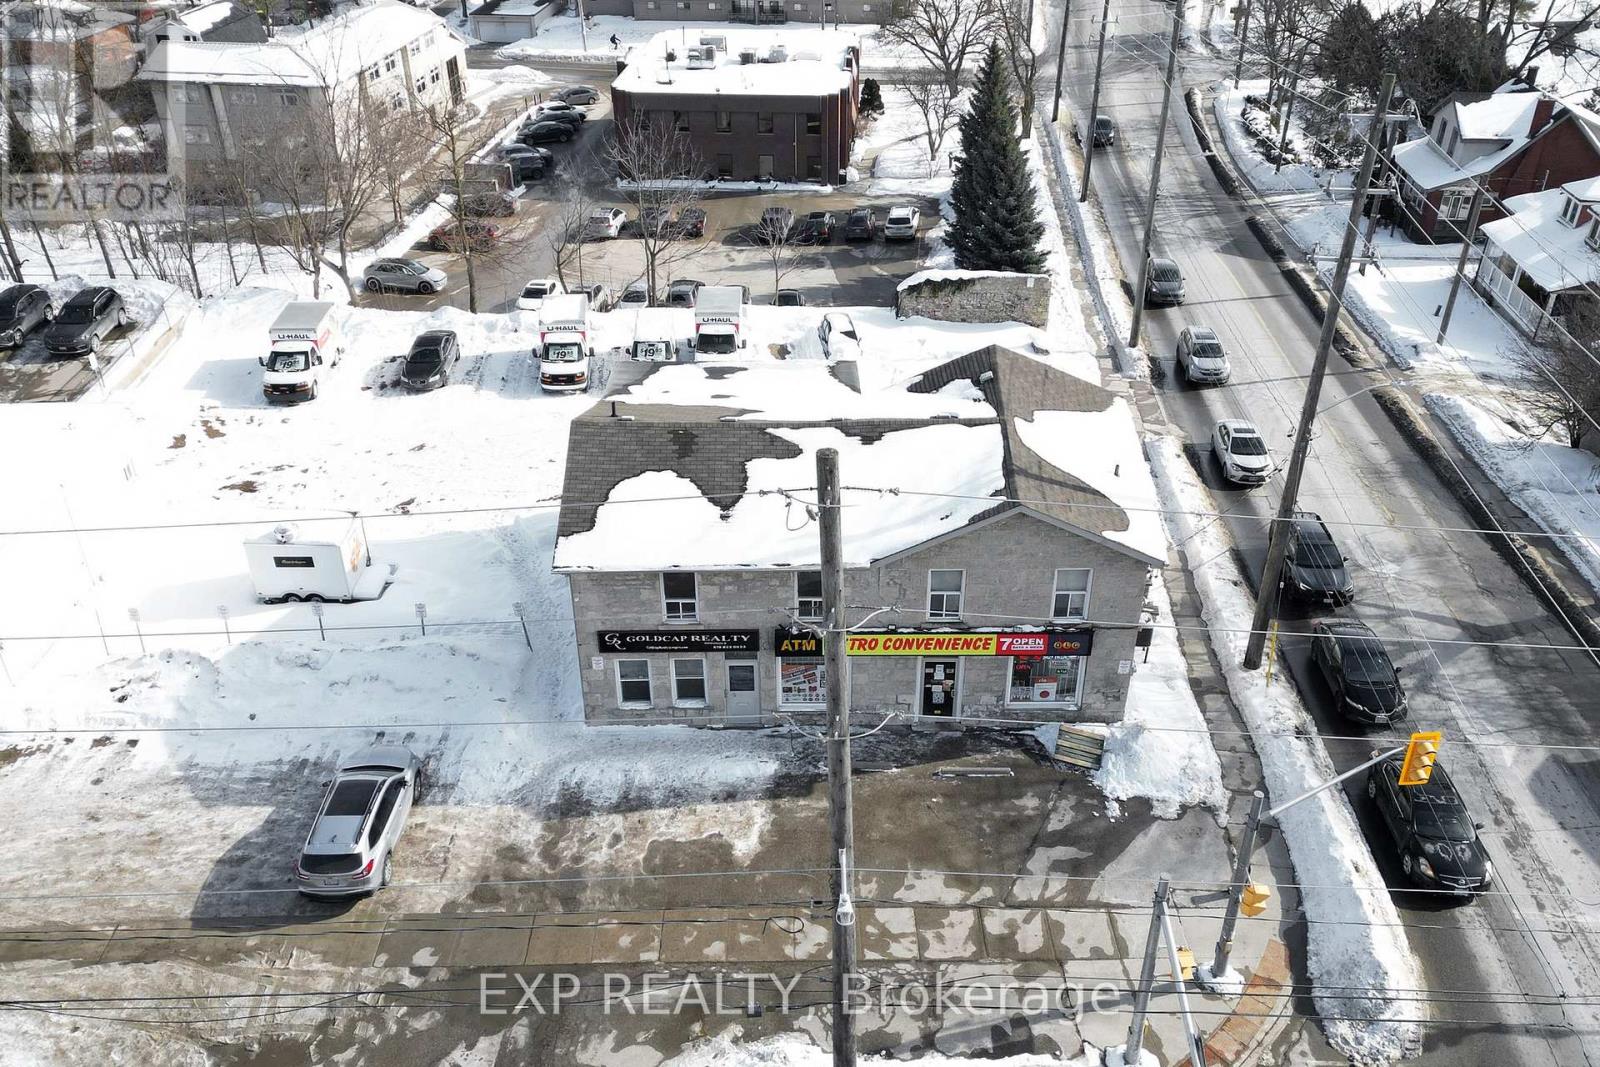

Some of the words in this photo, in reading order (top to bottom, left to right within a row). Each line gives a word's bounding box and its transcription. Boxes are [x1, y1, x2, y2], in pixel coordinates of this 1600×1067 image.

[626, 635, 688, 643] GOLDCAP
[691, 634, 751, 642] REALTY
[781, 639, 816, 651] ATM
[848, 637, 879, 651] TRO
[882, 637, 993, 651] CONVENIENCE
[999, 637, 1013, 651] 7
